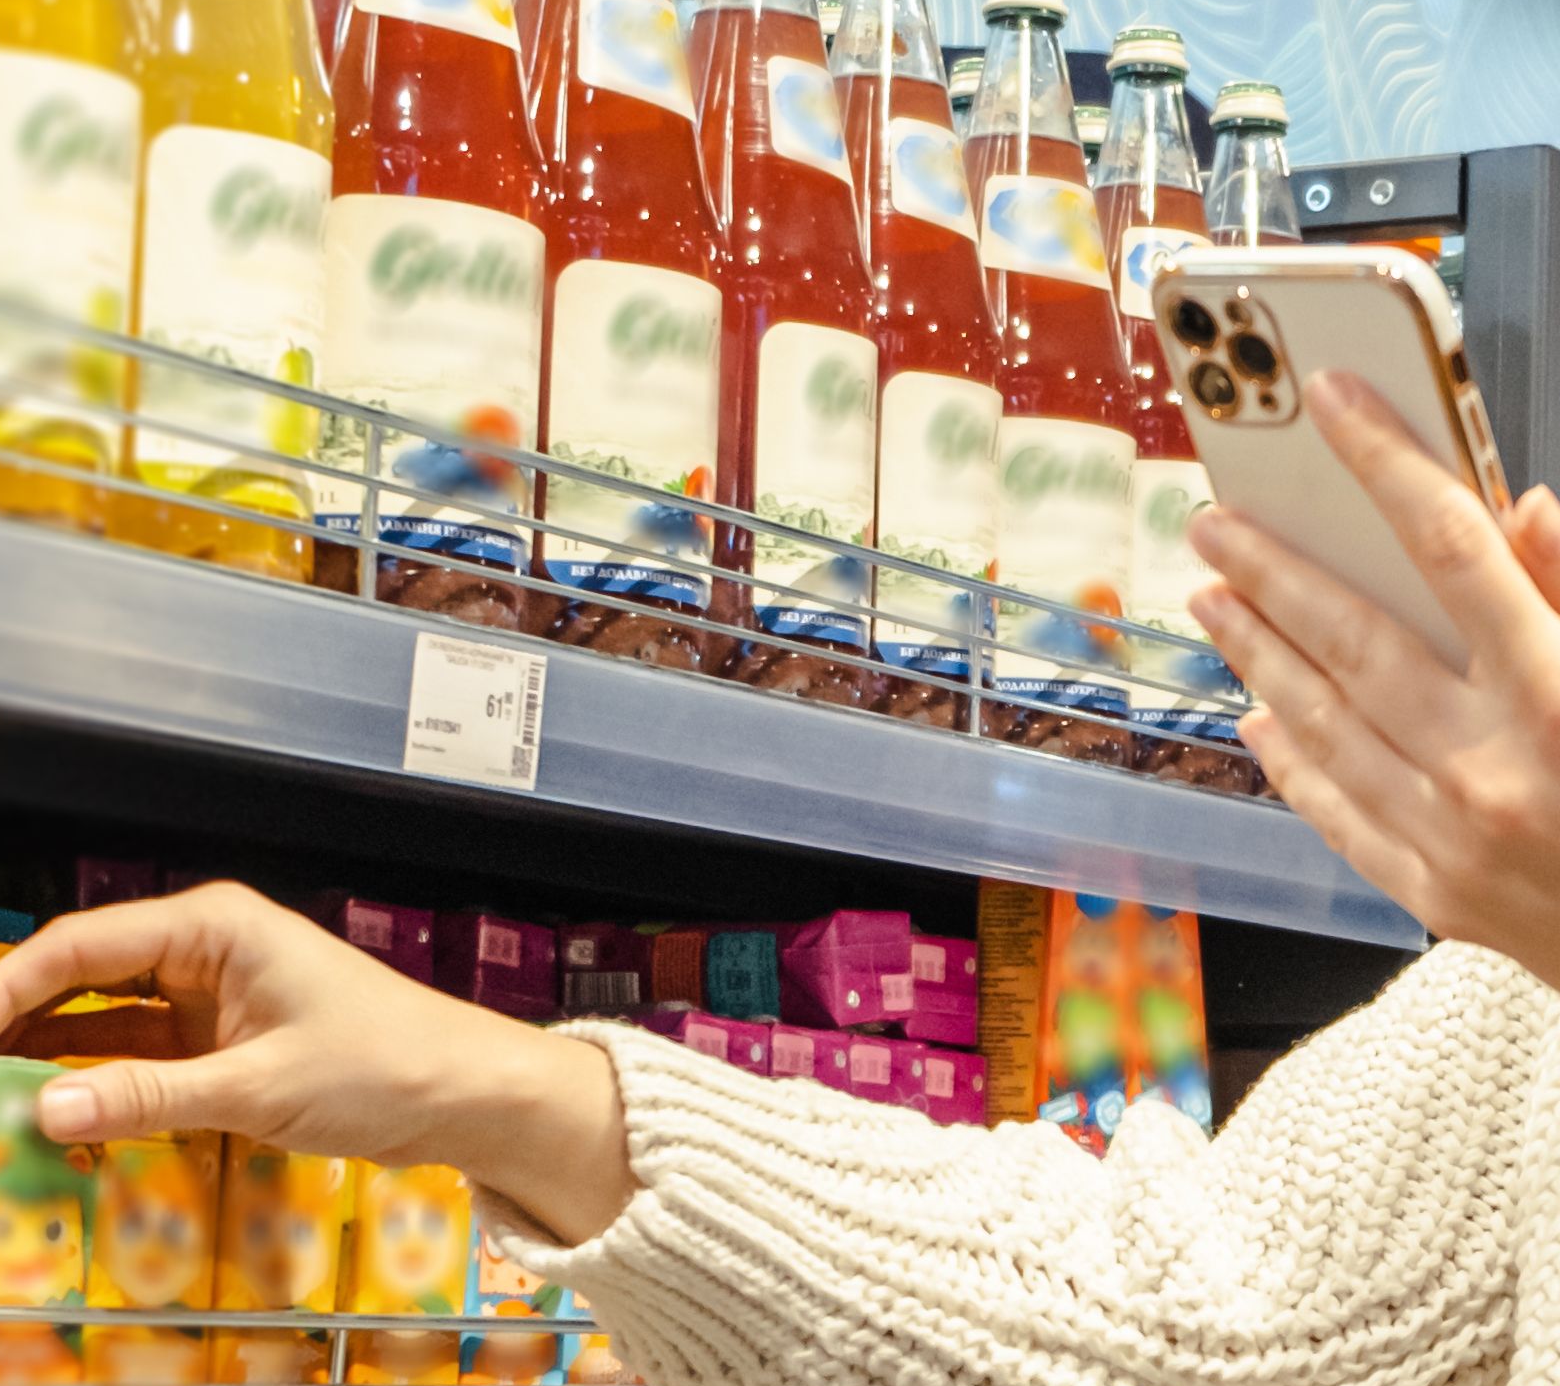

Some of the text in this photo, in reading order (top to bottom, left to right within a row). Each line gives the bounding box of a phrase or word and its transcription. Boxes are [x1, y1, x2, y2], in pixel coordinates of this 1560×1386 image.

[571, 564, 595, 577] БЕЗ
[597, 569, 672, 584] ДОДАВАННЯ
[994, 680, 1065, 694] ДОДАВАННЯ
[486, 694, 504, 720] 61
